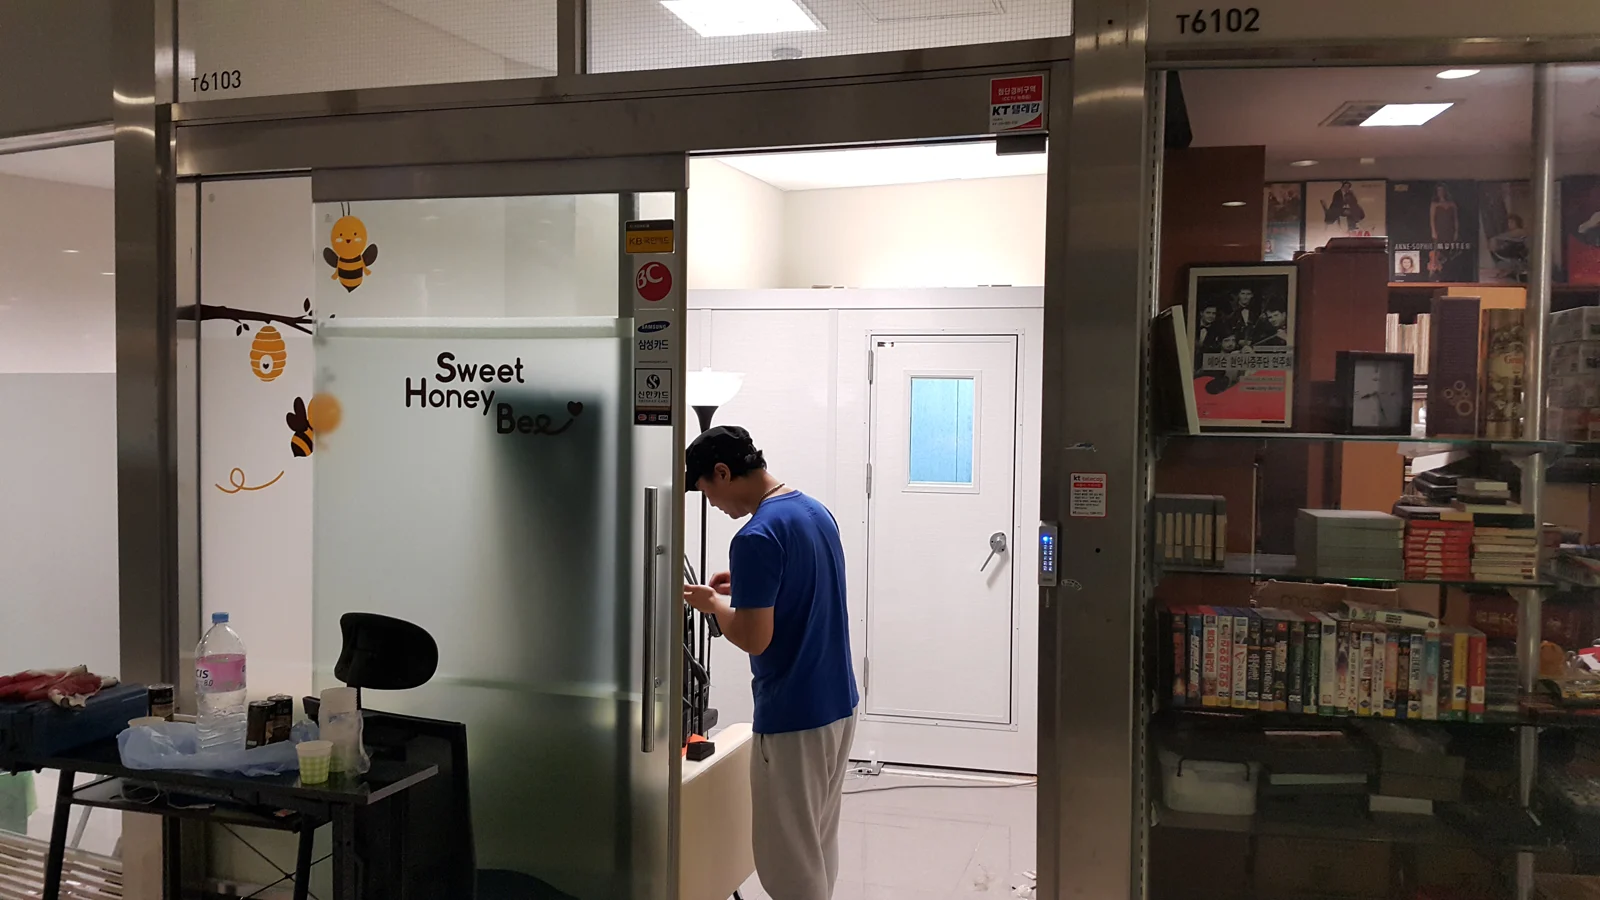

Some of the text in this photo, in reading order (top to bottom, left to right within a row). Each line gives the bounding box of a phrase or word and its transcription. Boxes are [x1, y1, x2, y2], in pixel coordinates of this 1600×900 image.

[1176, 7, 1260, 34] T6102
[191, 69, 241, 92] T6103
[1437, 242, 1471, 250] MUTTER
[636, 263, 664, 289] BC
[638, 339, 669, 351] 삼성카드
[435, 351, 525, 384] Sweet
[405, 377, 495, 416] Honey
[638, 390, 669, 399] 신한카드
[496, 402, 574, 436] Bee
